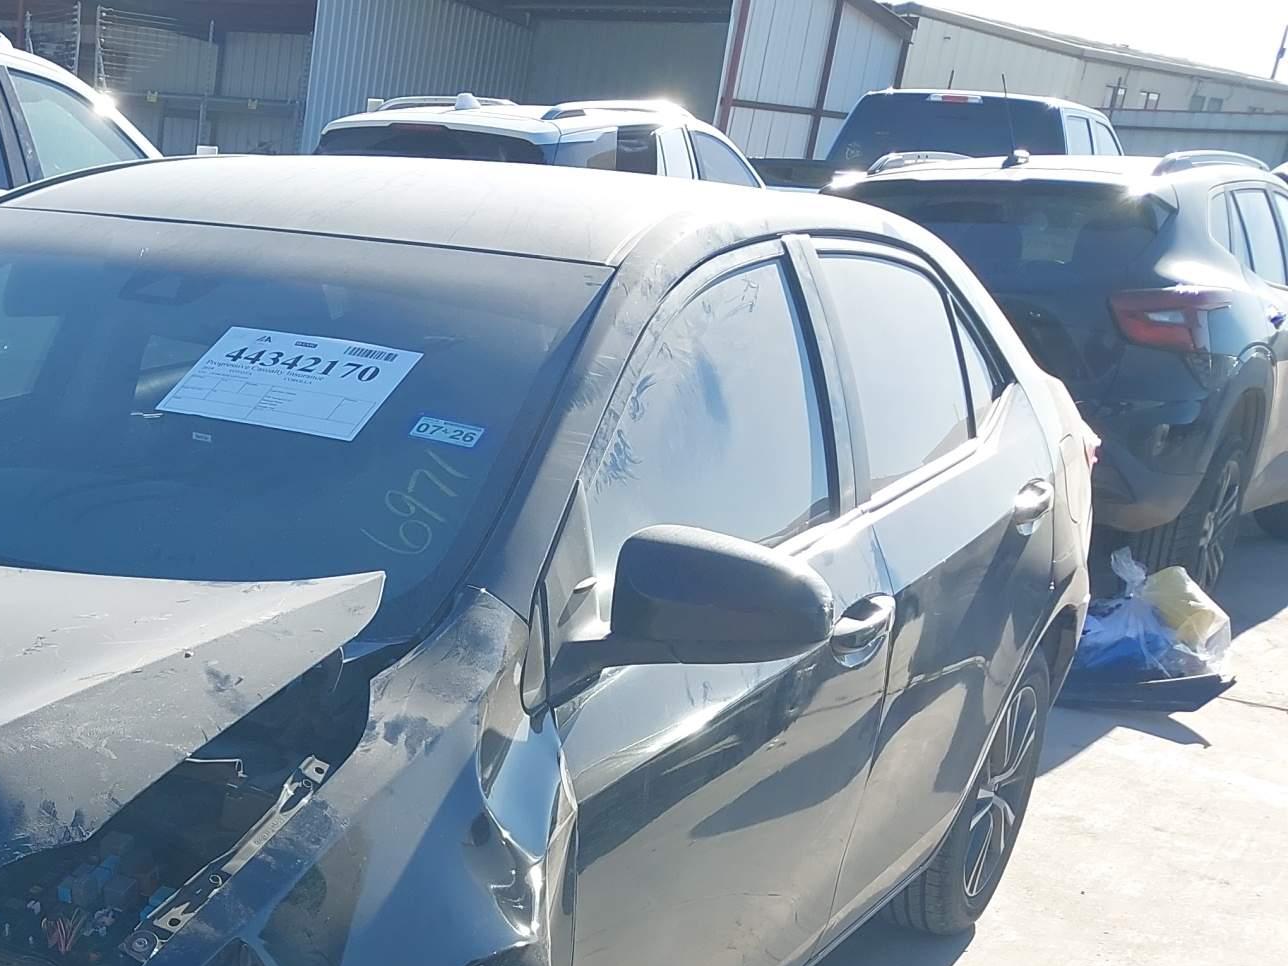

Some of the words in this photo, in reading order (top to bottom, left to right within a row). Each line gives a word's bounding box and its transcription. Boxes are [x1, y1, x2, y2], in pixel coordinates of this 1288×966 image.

[206, 359, 251, 370] Progressive
[251, 365, 285, 376] Casualty
[287, 371, 324, 381] Insurance
[225, 346, 380, 382] 44342170
[416, 423, 445, 435] 07
[448, 429, 477, 443] 26
